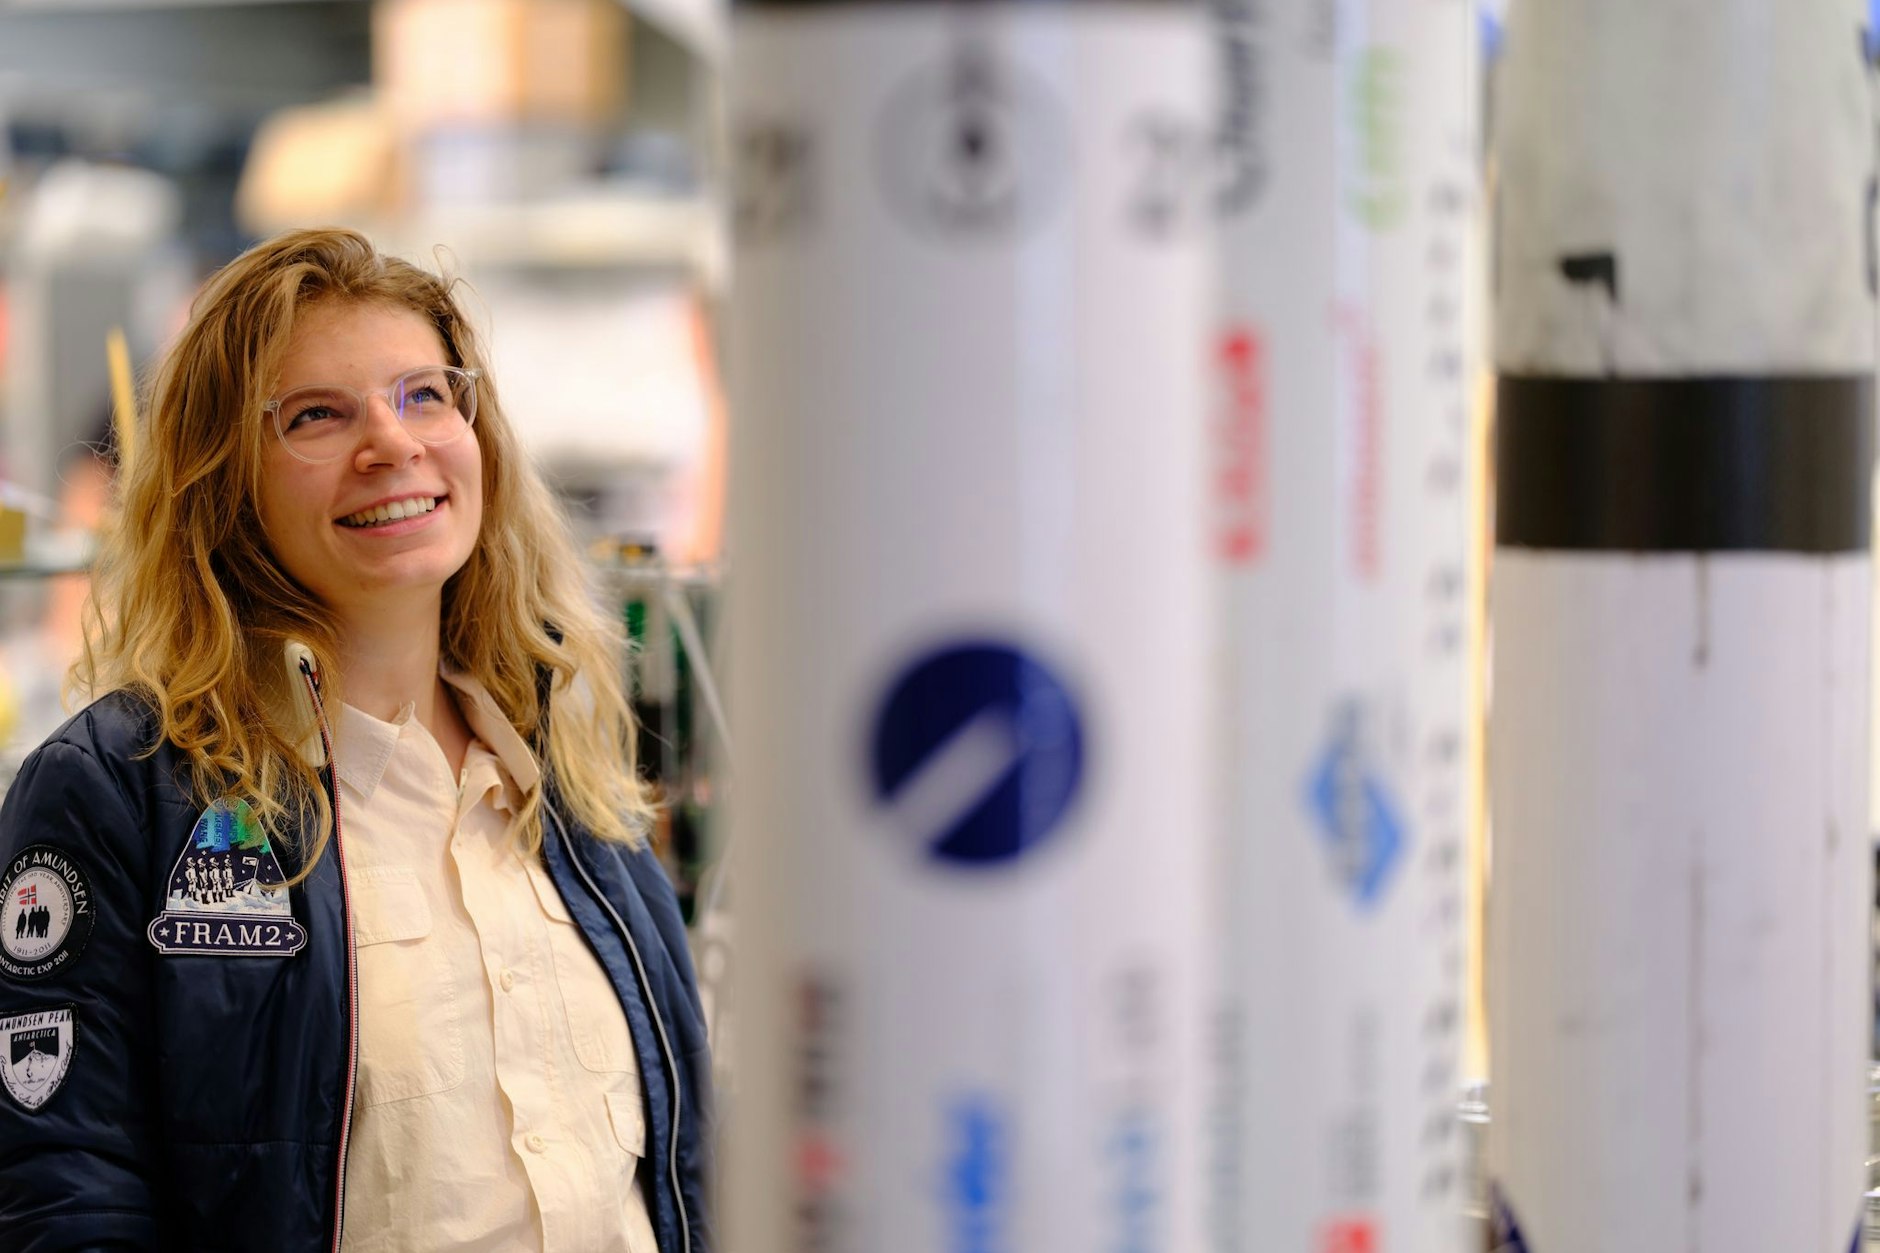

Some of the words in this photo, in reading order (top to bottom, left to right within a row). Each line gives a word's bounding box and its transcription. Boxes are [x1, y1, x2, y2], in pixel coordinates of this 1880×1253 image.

[14, 855, 28, 874] OF
[32, 851, 89, 914] AMUNDSEN
[174, 921, 282, 946] FRAM2
[13, 943, 52, 956] 1911-2011
[0, 955, 36, 976] NTARCTIC
[37, 963, 54, 975] EXP
[54, 949, 69, 966] 2011
[48, 1010, 72, 1023] PEAK
[13, 1030, 56, 1041] ANTARCTICA
